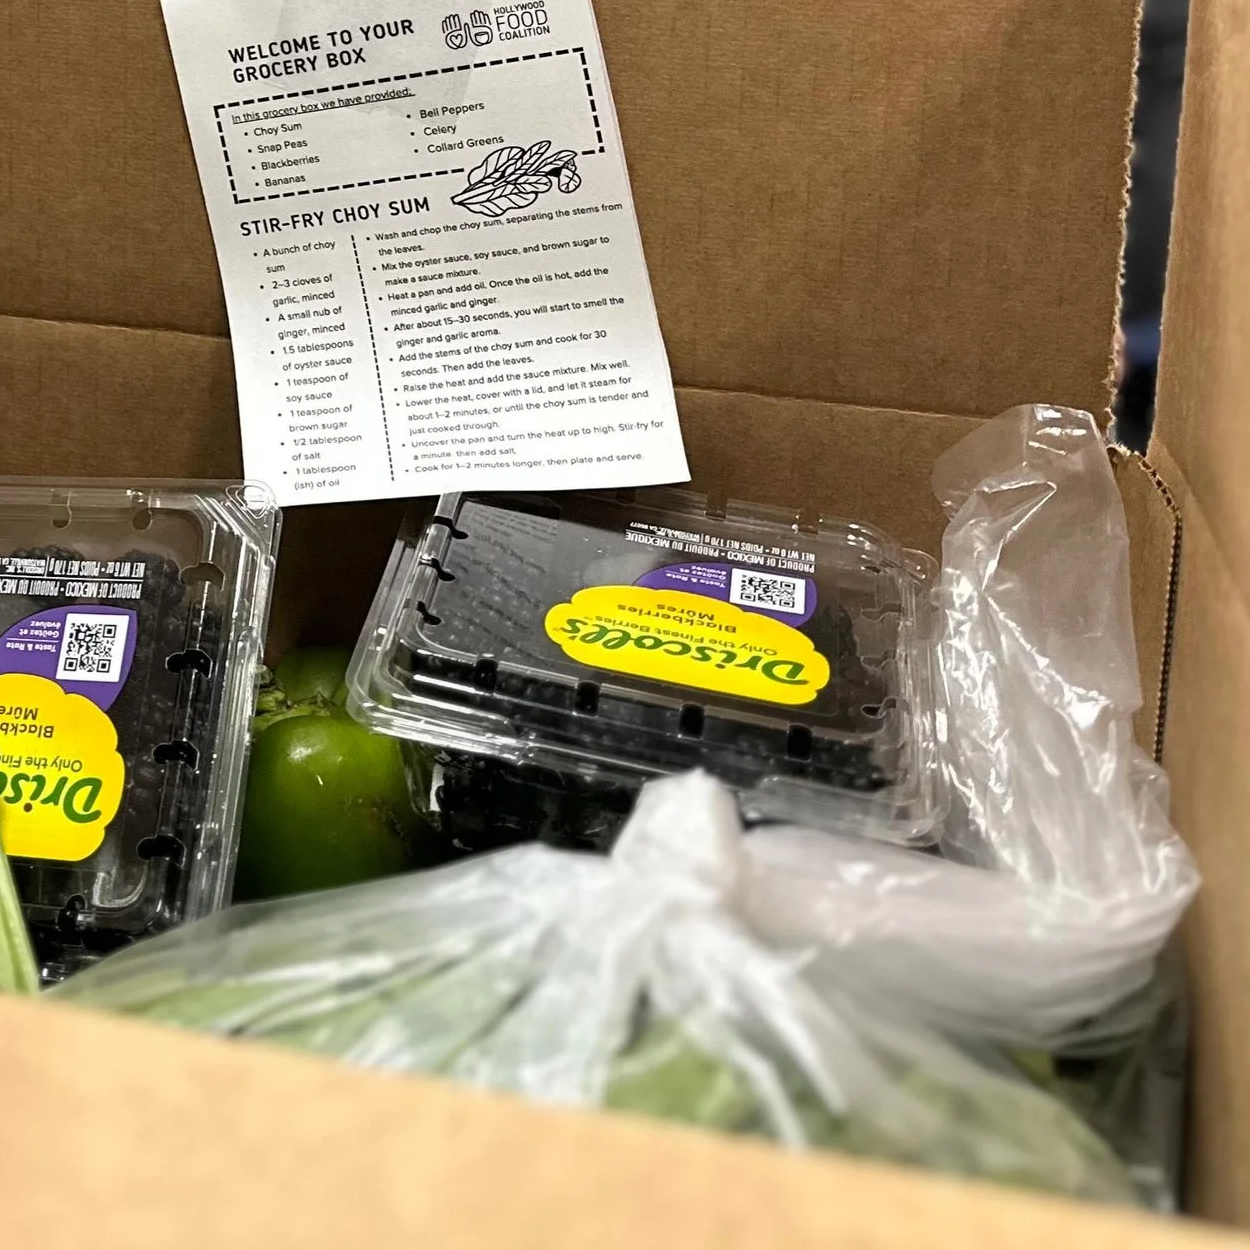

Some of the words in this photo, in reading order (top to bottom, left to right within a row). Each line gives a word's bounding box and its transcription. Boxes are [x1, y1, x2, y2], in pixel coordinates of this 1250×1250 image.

[494, 0, 544, 15] HOLLYWOOD
[496, 9, 548, 32] FOOD
[499, 25, 550, 41] COALITION
[227, 34, 321, 64] WELCOME
[326, 29, 352, 47] TO
[358, 19, 414, 41] YOUR
[232, 55, 317, 83] GROCERY
[325, 47, 366, 68] BOX
[232, 114, 241, 124] In
[243, 110, 258, 121] this
[263, 107, 298, 119] grocery
[301, 103, 320, 111] box
[321, 101, 335, 109] we
[338, 95, 361, 107] have
[419, 107, 440, 119] Bell
[440, 102, 485, 116] Peppers
[253, 126, 279, 137] Choy
[280, 123, 302, 133] Sum
[423, 125, 457, 136] Celery
[256, 143, 282, 154] Snap
[283, 139, 308, 149] Peas
[426, 140, 464, 153] Collard
[465, 135, 504, 148] Greens
[260, 155, 320, 171] Blackberries
[263, 175, 306, 187] Bananas
[239, 210, 324, 236] STIR-FRY
[332, 203, 380, 224] CHOY
[388, 196, 430, 216] SUM
[374, 231, 399, 241] Wash
[400, 228, 418, 238] and
[418, 226, 442, 236] chop
[442, 224, 458, 232] the
[459, 221, 481, 230] choy
[505, 212, 554, 224] separating
[554, 209, 570, 217] the
[571, 206, 600, 216] stems
[600, 203, 623, 211] from
[262, 248, 271, 257] A
[271, 244, 300, 256] bunch
[301, 242, 311, 252] of
[312, 241, 336, 250] choy
[377, 247, 393, 256] the
[380, 262, 398, 271] Mix
[397, 261, 413, 269] the
[414, 257, 441, 268] oyster
[473, 252, 490, 260] soy
[522, 243, 540, 254] and
[540, 241, 571, 251] brown
[571, 237, 598, 248] sugar
[599, 236, 610, 244] to
[265, 264, 285, 274] sum
[292, 276, 322, 287] cloves
[323, 273, 332, 283] of
[384, 277, 409, 286] make
[417, 272, 444, 282] sauce
[301, 289, 335, 302] minced
[277, 313, 286, 322] A
[287, 309, 311, 321] small
[312, 307, 331, 317] nub
[332, 305, 342, 315] of
[390, 304, 422, 316] minced
[423, 302, 448, 314] garlic
[449, 299, 467, 309] and
[311, 321, 346, 334] minced
[296, 339, 354, 353] tablespoons
[281, 361, 291, 371] of
[293, 360, 322, 371] oyster
[324, 356, 352, 367] sauce
[286, 378, 291, 386] 1
[292, 375, 337, 386] teaspoon
[338, 371, 348, 381] of
[285, 395, 302, 403] soy
[304, 391, 333, 401] sauce
[289, 409, 294, 417] 1
[296, 406, 341, 417] teaspoon
[342, 403, 353, 413] of
[288, 423, 319, 432] brown
[321, 421, 347, 430] sugar
[308, 434, 362, 445] tablespoon
[291, 452, 301, 461] of
[304, 452, 320, 460] salt
[295, 467, 300, 475] 1
[301, 464, 356, 474] tablespoon
[315, 479, 326, 488] of
[328, 479, 340, 487] oil
[624, 531, 671, 548] MEXIQUE
[671, 538, 684, 551] DU
[684, 540, 720, 557] PRODUIT
[726, 549, 765, 565] MEXICO
[765, 555, 777, 567] OF
[777, 556, 815, 573] PRODUCT
[17, 579, 29, 594] DU
[28, 580, 60, 596] PRODUIT
[64, 581, 98, 598] MEXICO
[98, 582, 108, 598] OF
[108, 583, 142, 599] PRODUCT
[617, 604, 737, 633] Blackberries
[656, 603, 715, 622] Mûres
[655, 627, 705, 644] Finest
[6, 642, 25, 650] Rate
[27, 643, 32, 651] &
[34, 644, 56, 652] Taste
[561, 617, 809, 686] Driscoll's
[708, 638, 735, 651] the
[739, 642, 778, 656] Only
[25, 756, 48, 770] the
[51, 756, 82, 772] Only
